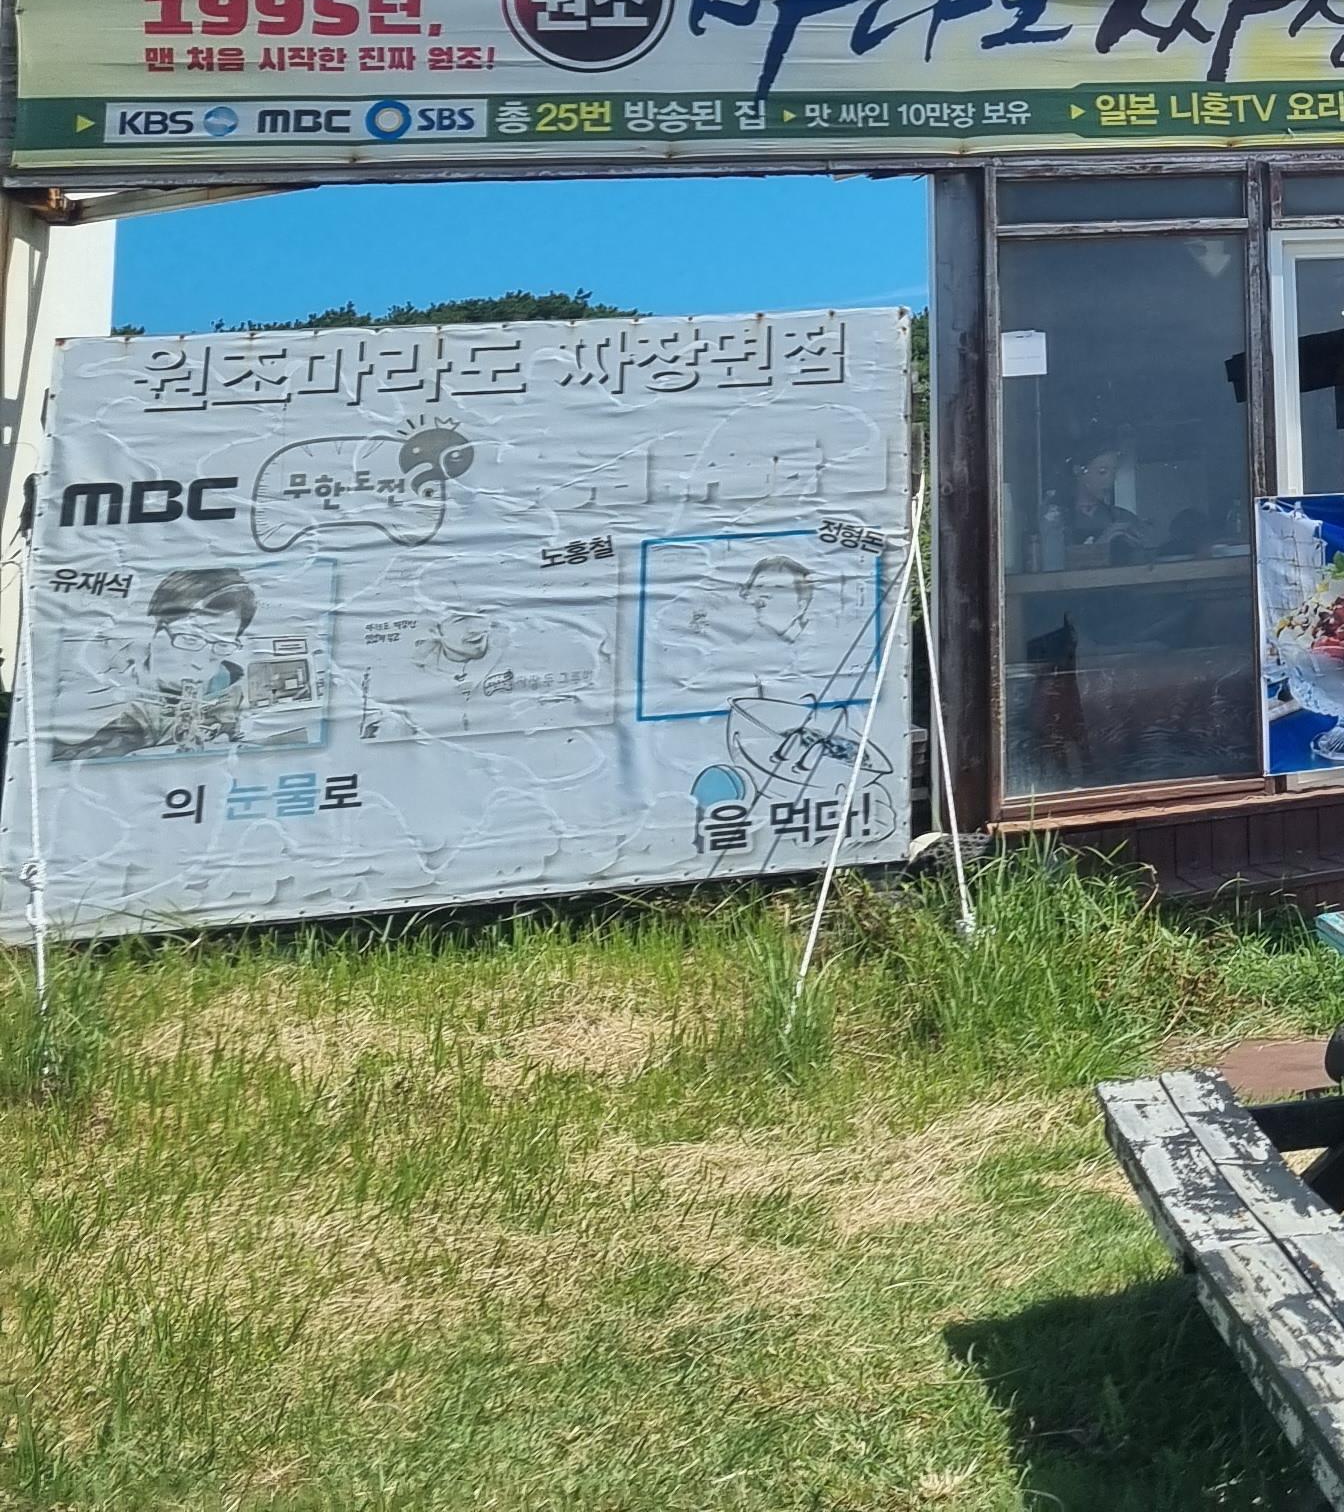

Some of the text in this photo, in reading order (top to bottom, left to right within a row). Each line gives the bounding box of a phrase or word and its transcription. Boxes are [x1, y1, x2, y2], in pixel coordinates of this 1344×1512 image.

[145, 46, 494, 72] 맨 처음 시작한 진짜 원조!
[119, 107, 475, 135] KBS MBC SBS
[495, 100, 766, 134] 총 25번 방송된 집
[805, 100, 1032, 128] 맛 싸인 10만장 보유
[1095, 92, 1160, 126] 일본
[1170, 91, 1277, 125] 니혼TV
[555, 322, 845, 394] 짜장면집
[60, 477, 238, 527] MBC
[284, 470, 405, 510] 무한도전
[539, 519, 885, 569] 노홍철 정형돈
[49, 567, 134, 599] 유재석
[161, 772, 363, 824] 의 눈물로
[704, 792, 870, 851] 을 먹다!
